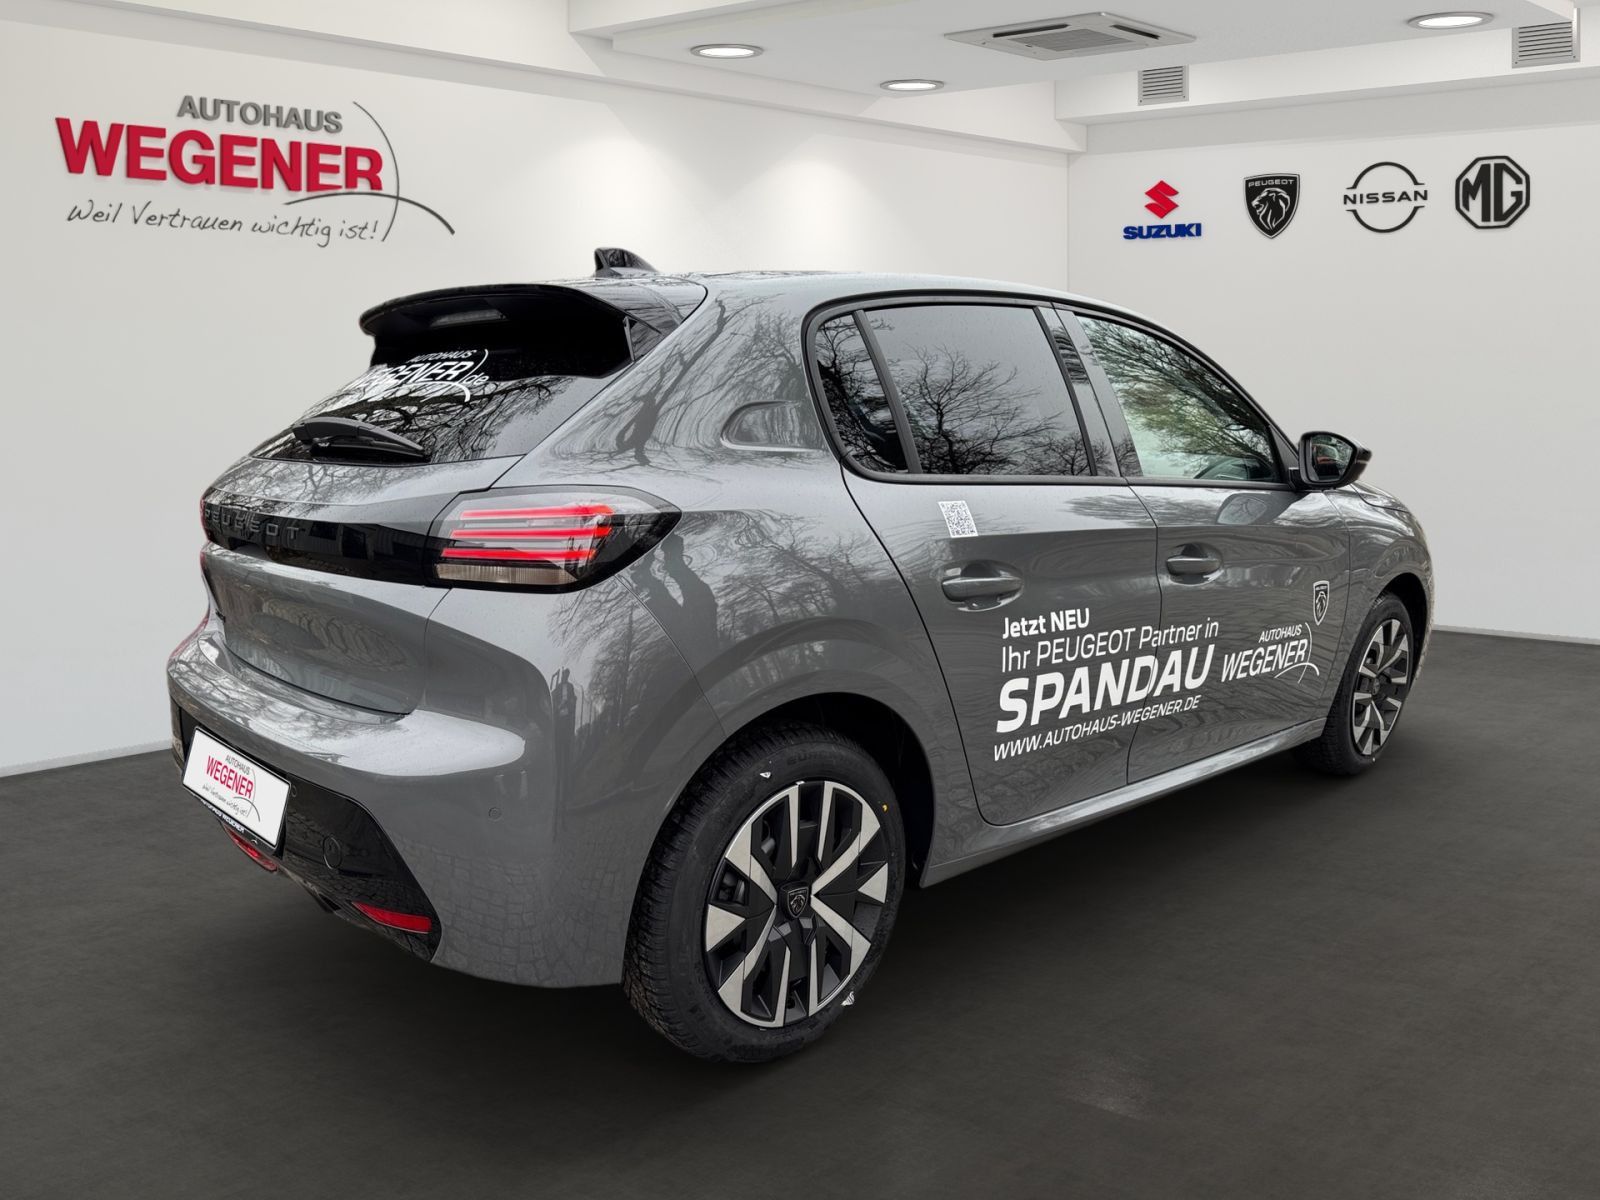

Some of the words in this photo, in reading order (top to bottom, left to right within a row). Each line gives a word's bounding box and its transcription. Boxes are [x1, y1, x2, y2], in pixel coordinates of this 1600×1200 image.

[177, 95, 343, 133] AUTOHAUS
[55, 117, 383, 192] WEGENER
[1248, 178, 1295, 188] PEUGEOT
[1343, 189, 1429, 206] NISSAN
[1462, 163, 1524, 223] MG
[67, 200, 123, 222] Weil
[131, 201, 242, 232] Vertrauen
[251, 216, 331, 248] wichtig
[338, 220, 379, 241] ist!
[1123, 223, 1202, 239] SUZUKI
[1002, 617, 1046, 639] Jetzt
[1050, 608, 1090, 633] NEU
[1002, 646, 1031, 672] Ihr
[1036, 628, 1136, 667] PEUGEOT
[1139, 625, 1203, 650] Partner
[1204, 617, 1219, 639] in
[1259, 624, 1302, 642] AUTOHAUS
[1221, 639, 1309, 683] WEGENER
[996, 644, 1215, 733] SPANDAU
[993, 695, 1202, 762] WWW.AUTOHAUS-WEGENER.DE
[207, 755, 254, 799] WEGENER
[225, 755, 251, 775] AUTOHAUS
